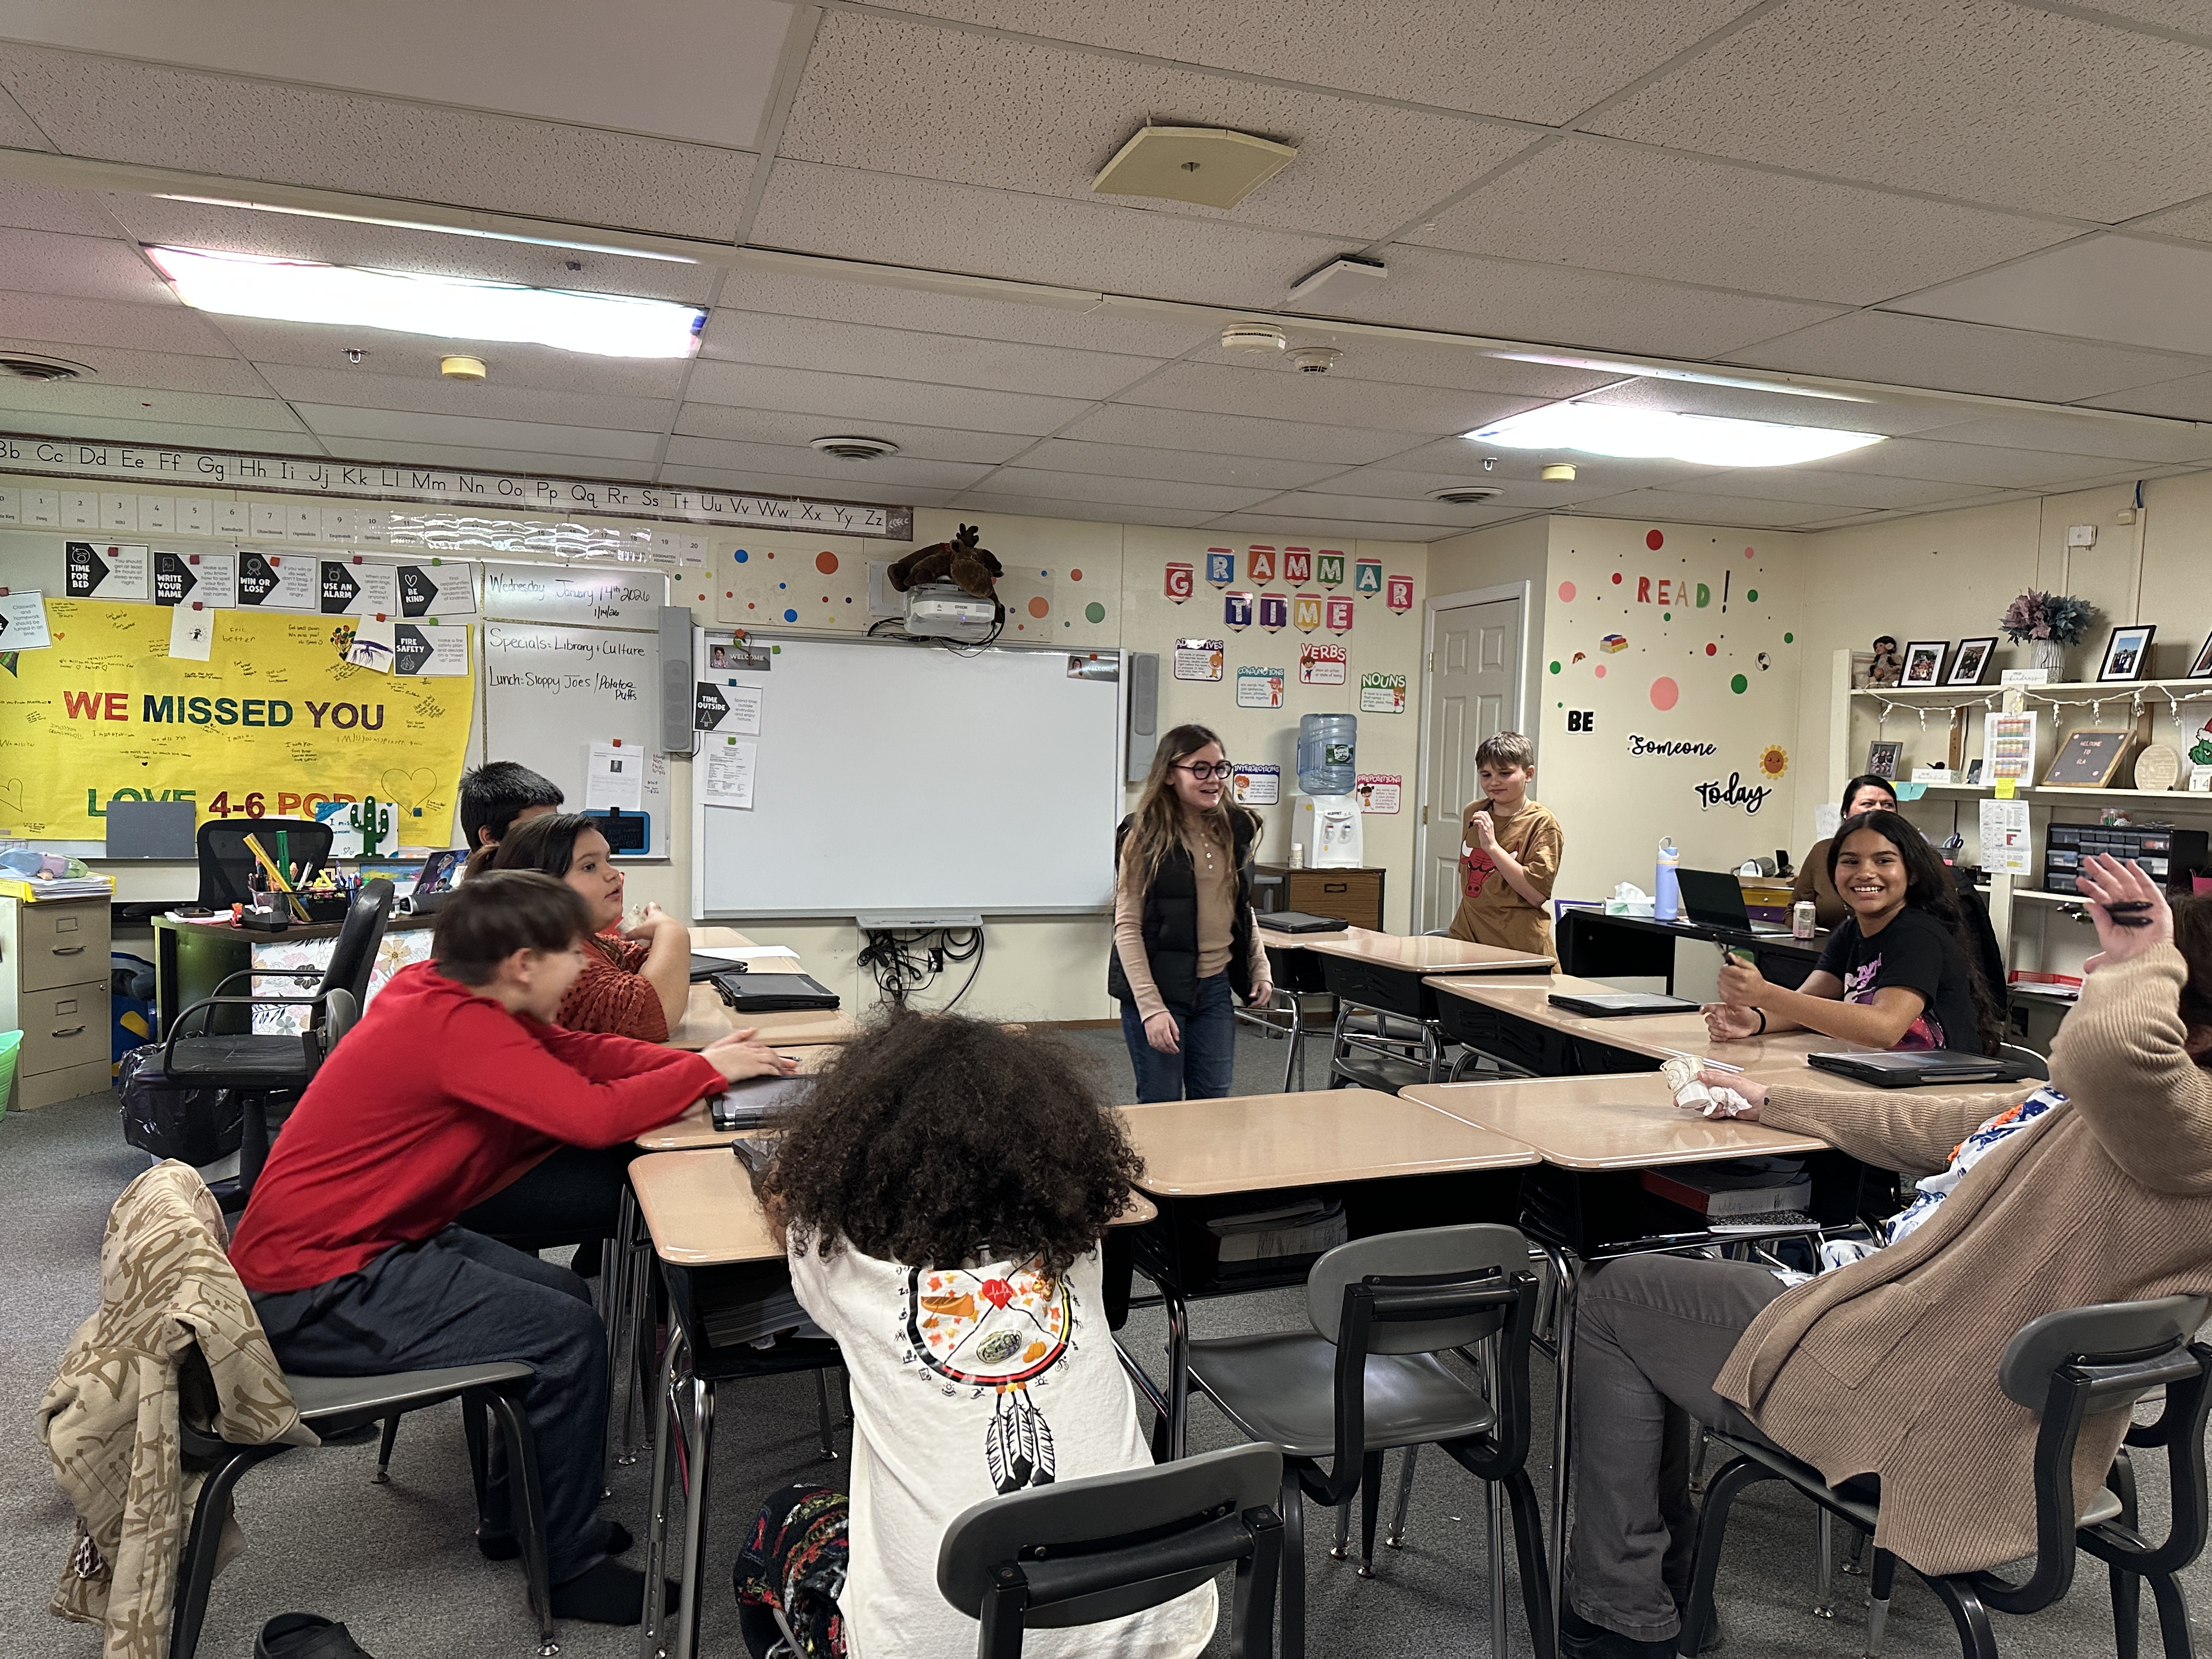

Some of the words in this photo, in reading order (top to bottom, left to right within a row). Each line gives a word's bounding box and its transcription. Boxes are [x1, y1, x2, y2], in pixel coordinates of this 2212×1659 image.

[37, 444, 63, 462] Cc
[80, 447, 106, 466] Dd
[122, 450, 144, 468] Ee
[160, 453, 181, 471] Ff
[198, 456, 224, 481] Gg
[240, 459, 266, 477] Hh
[281, 462, 294, 479] Ii
[309, 465, 329, 489] Jj
[343, 467, 367, 486] Kk
[382, 470, 398, 487] Ll
[413, 472, 445, 490] Mm
[460, 476, 484, 494] Nn
[498, 479, 522, 496] Oo
[537, 482, 557, 505] Pp
[571, 485, 598, 509] Qq
[608, 488, 629, 504] Rr
[642, 490, 658, 507] Ss
[670, 493, 689, 509] Tt
[702, 495, 721, 512] Uu
[730, 498, 748, 514] Vv
[757, 500, 788, 518] Ww
[802, 505, 821, 521] Xx
[833, 507, 852, 529] Yy
[865, 510, 882, 526] Zz
[157, 574, 182, 582] WRITE
[158, 582, 182, 590] YOUR
[1170, 554, 1409, 605] GRAMMAR
[157, 590, 182, 598] NAME
[244, 585, 264, 593] LOSE
[323, 590, 352, 599] ALARM
[490, 573, 545, 601] Wednesday
[555, 579, 594, 607] January
[620, 587, 650, 602] 2026
[1637, 570, 1730, 613] READ!
[1231, 600, 1347, 626] TIME
[555, 635, 594, 661] Library
[603, 640, 645, 657] Culture
[1176, 639, 1223, 650] ADIVES
[1301, 644, 1346, 661] VERBS
[526, 672, 560, 695] Sloppy
[564, 674, 591, 689] Joes
[1362, 673, 1405, 687] NOUNS
[615, 689, 637, 701] Puffs
[64, 691, 128, 721] WE
[143, 694, 293, 727] MISSED
[304, 700, 384, 730] YOU
[697, 702, 726, 711] OUTSIDE
[1568, 711, 1594, 732] BE
[1629, 735, 1717, 756] Someone
[1234, 764, 1279, 772] INTERJECTIONS
[1358, 775, 1401, 783] PREPOSITIONS
[208, 791, 266, 819] 4-6
